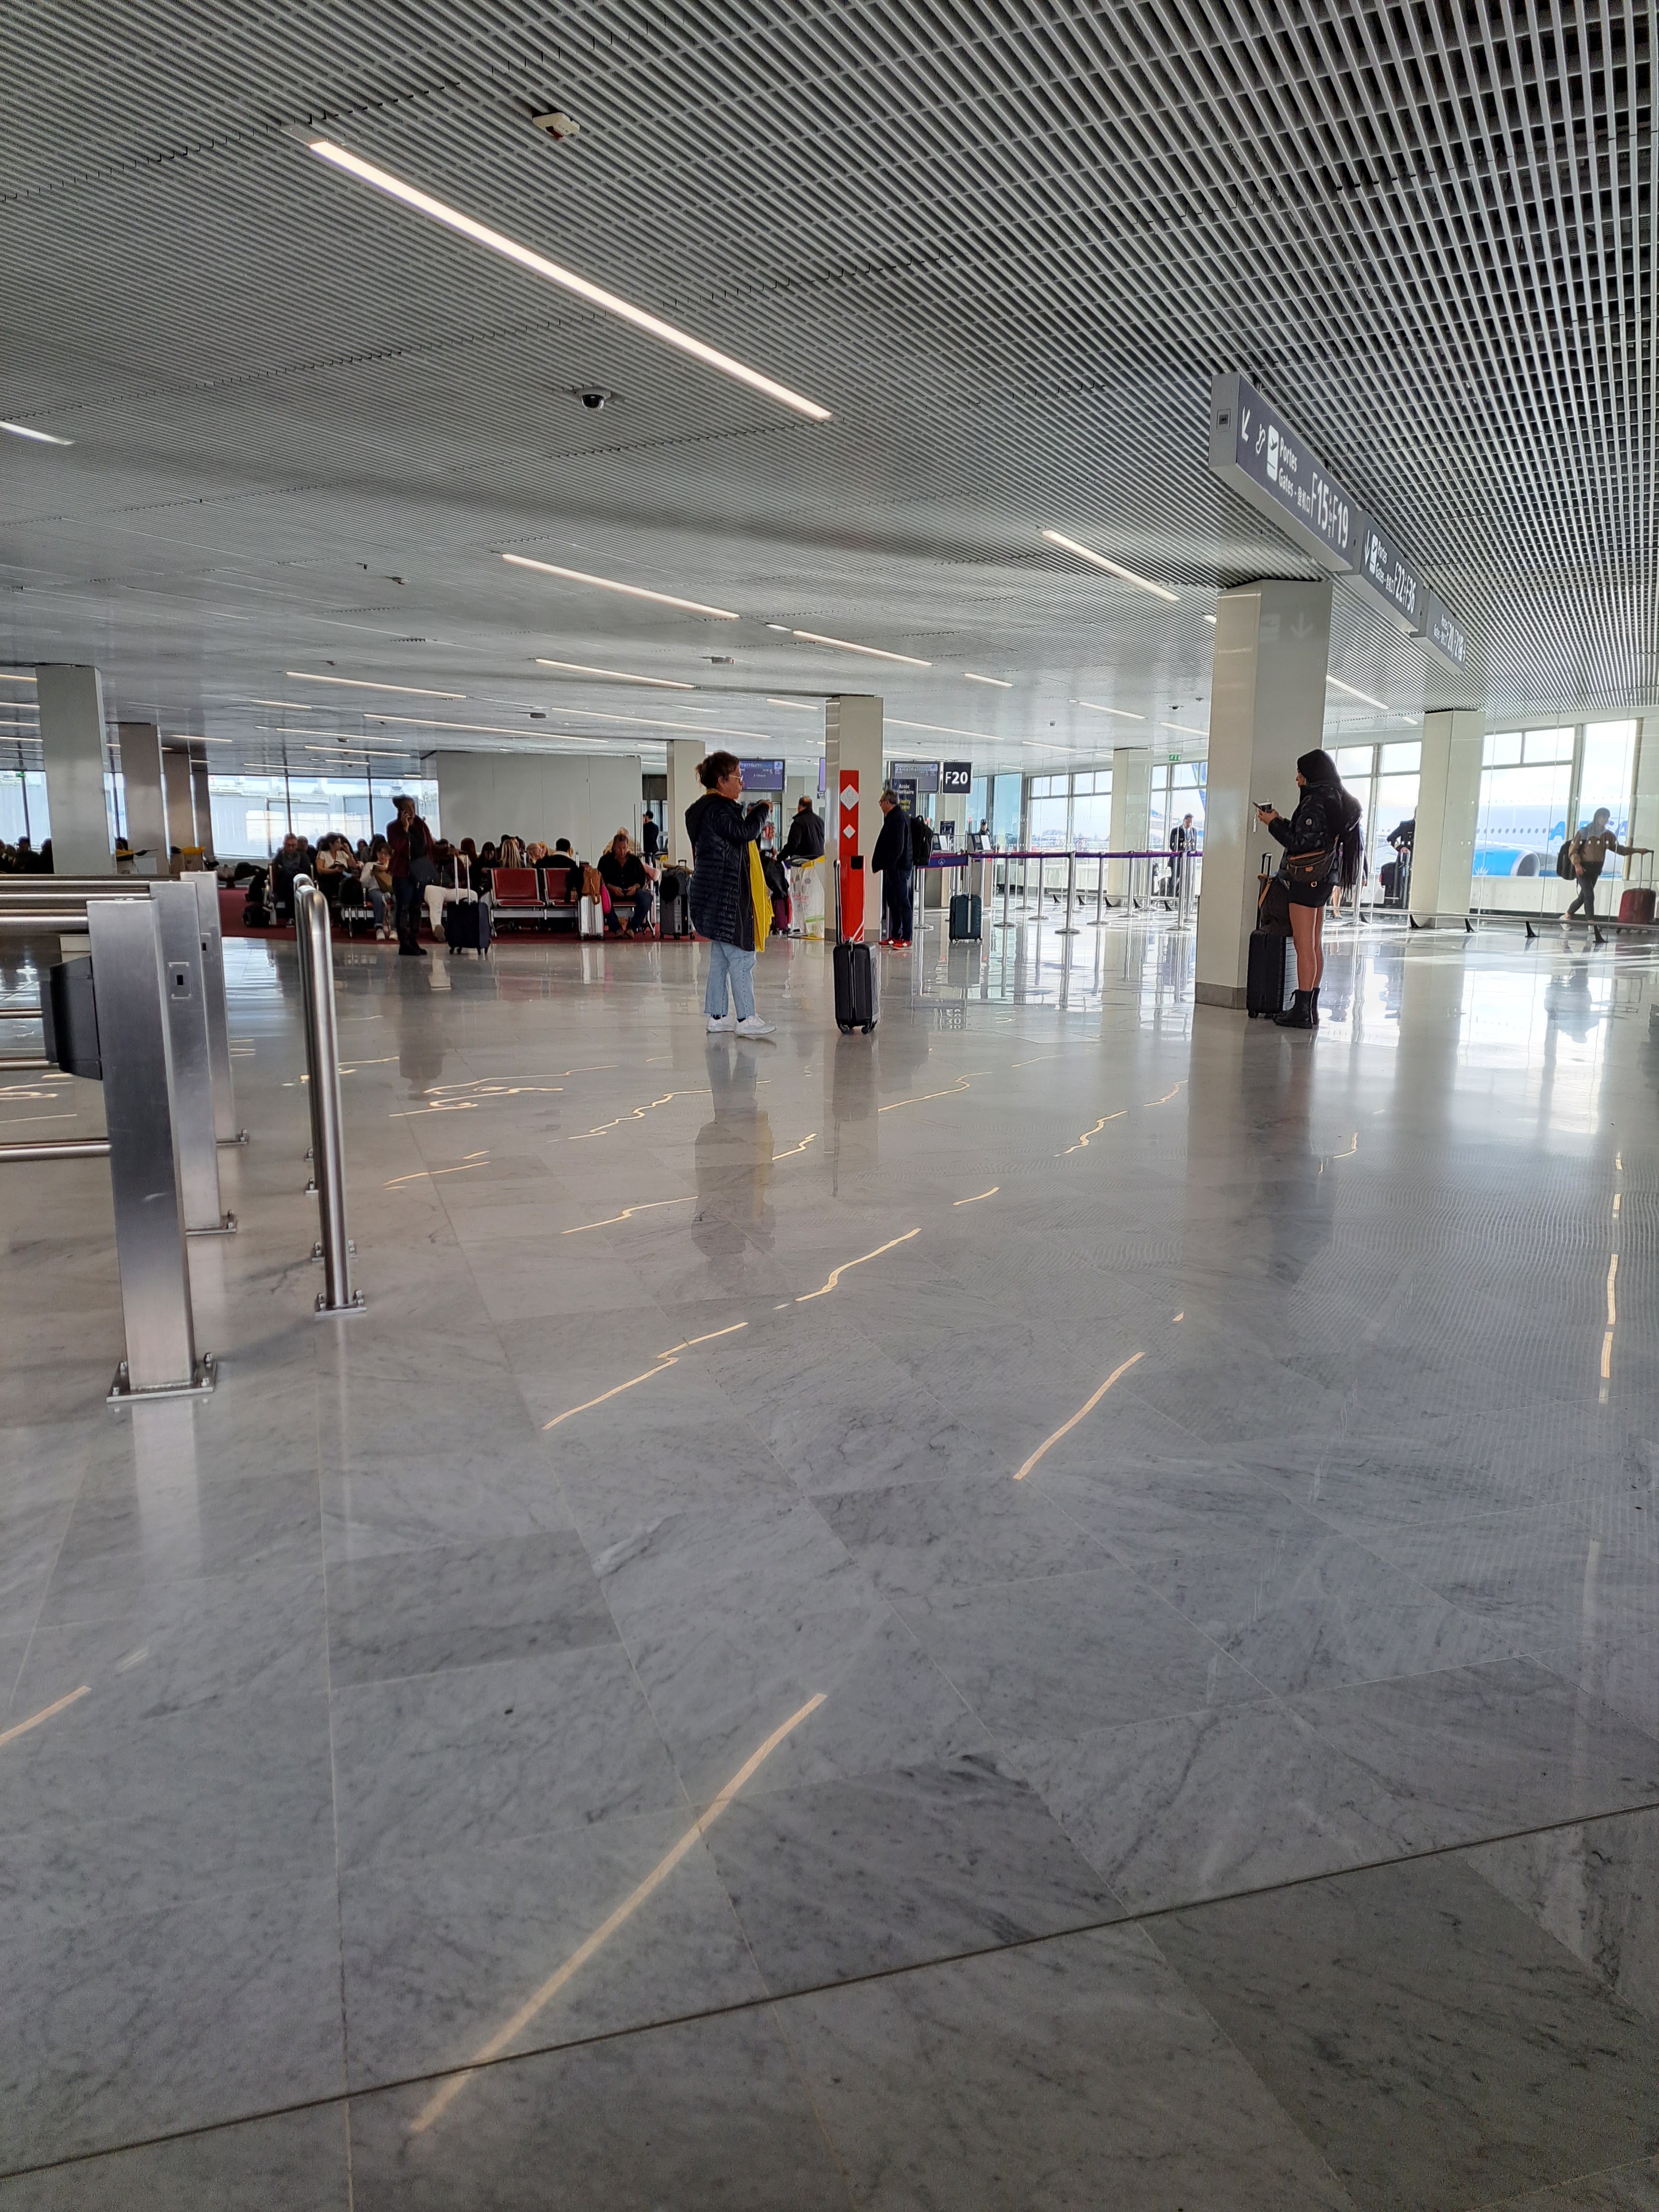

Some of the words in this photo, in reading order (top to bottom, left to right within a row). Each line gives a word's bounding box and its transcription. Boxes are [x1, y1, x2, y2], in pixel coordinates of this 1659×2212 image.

[1280, 436, 1297, 473] Portes
[1279, 467, 1294, 498] Gates
[1310, 471, 1329, 531] F15
[1332, 494, 1349, 549] F19
[945, 771, 968, 785] F20
